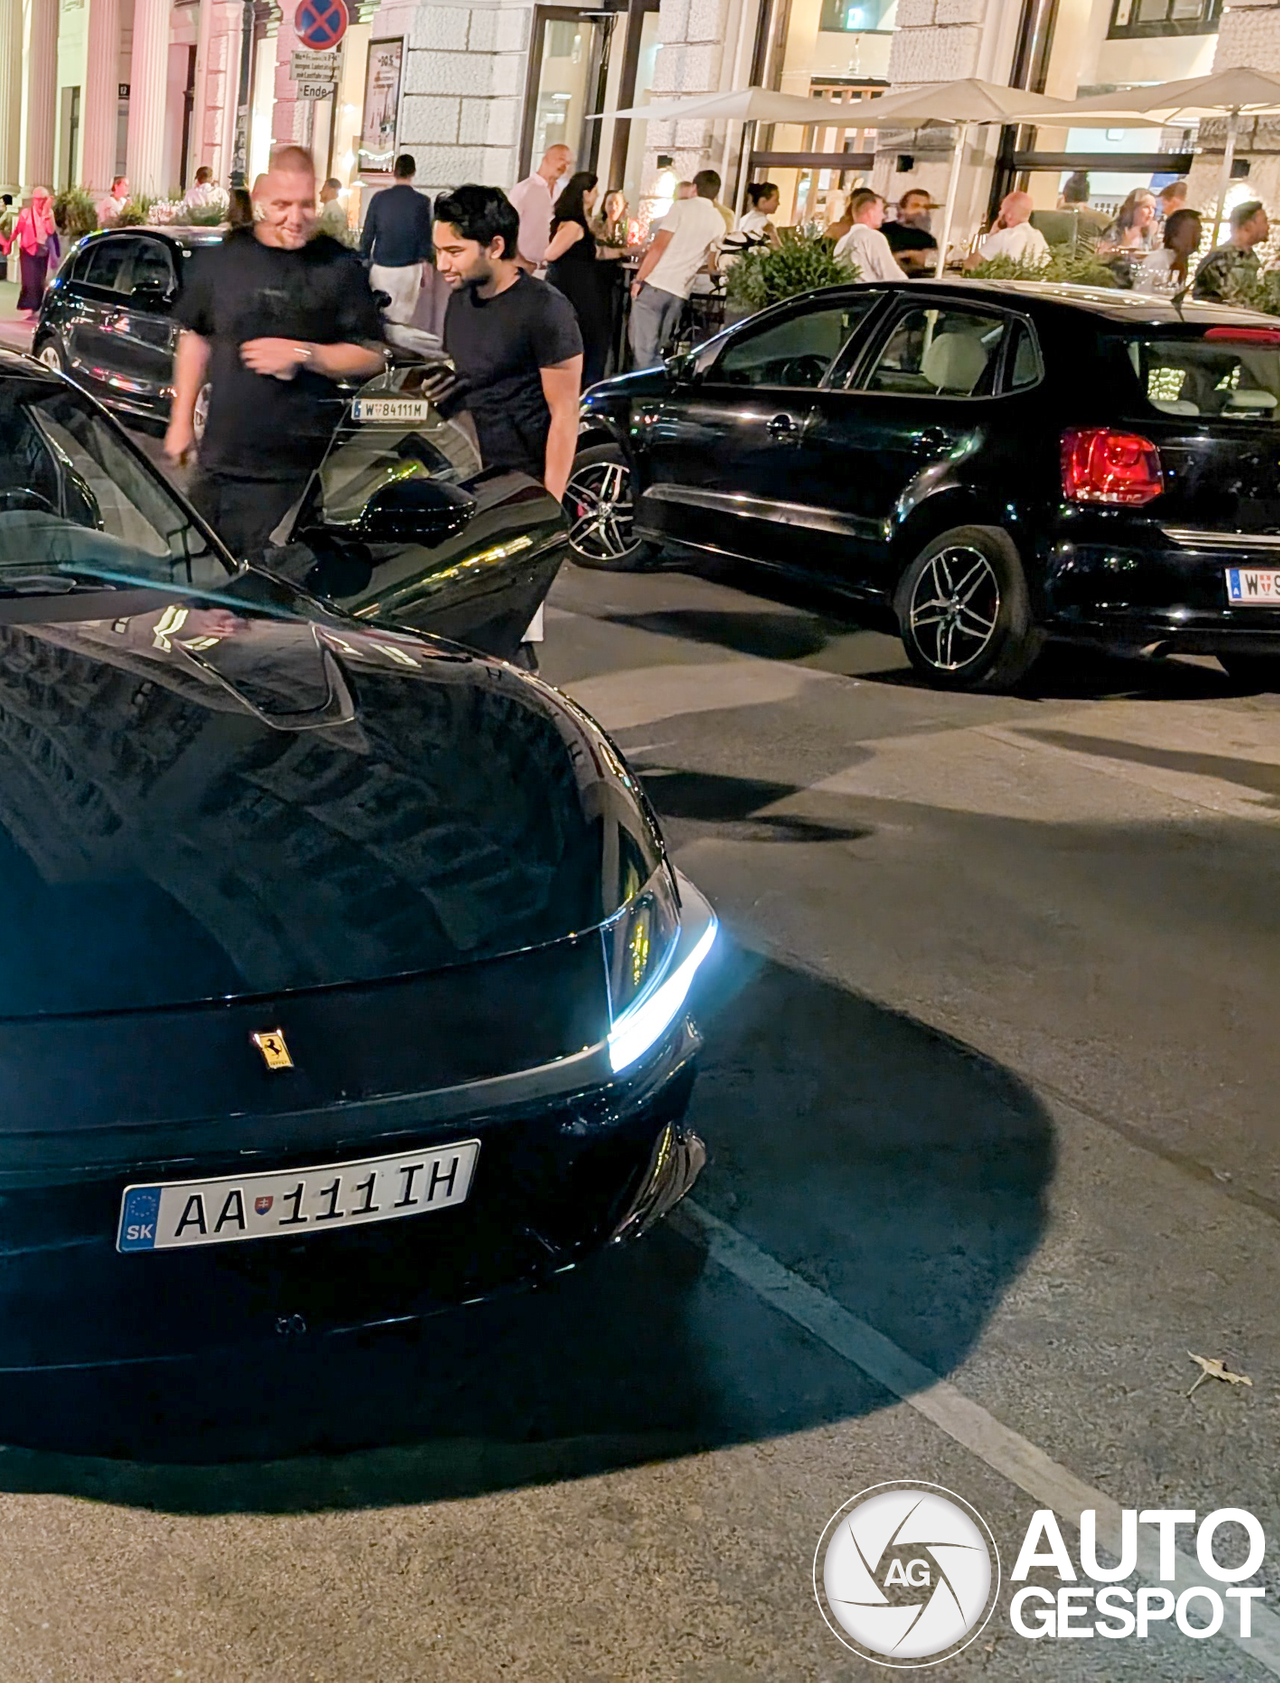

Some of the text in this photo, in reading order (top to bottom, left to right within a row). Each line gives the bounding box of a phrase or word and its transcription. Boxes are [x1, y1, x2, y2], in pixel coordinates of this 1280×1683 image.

[303, 84, 327, 97] Ende
[366, 403, 422, 416] W 84111M
[1233, 587, 1240, 595] A
[1245, 573, 1258, 595] W
[174, 1188, 247, 1237] AA
[126, 1224, 153, 1241] SK
